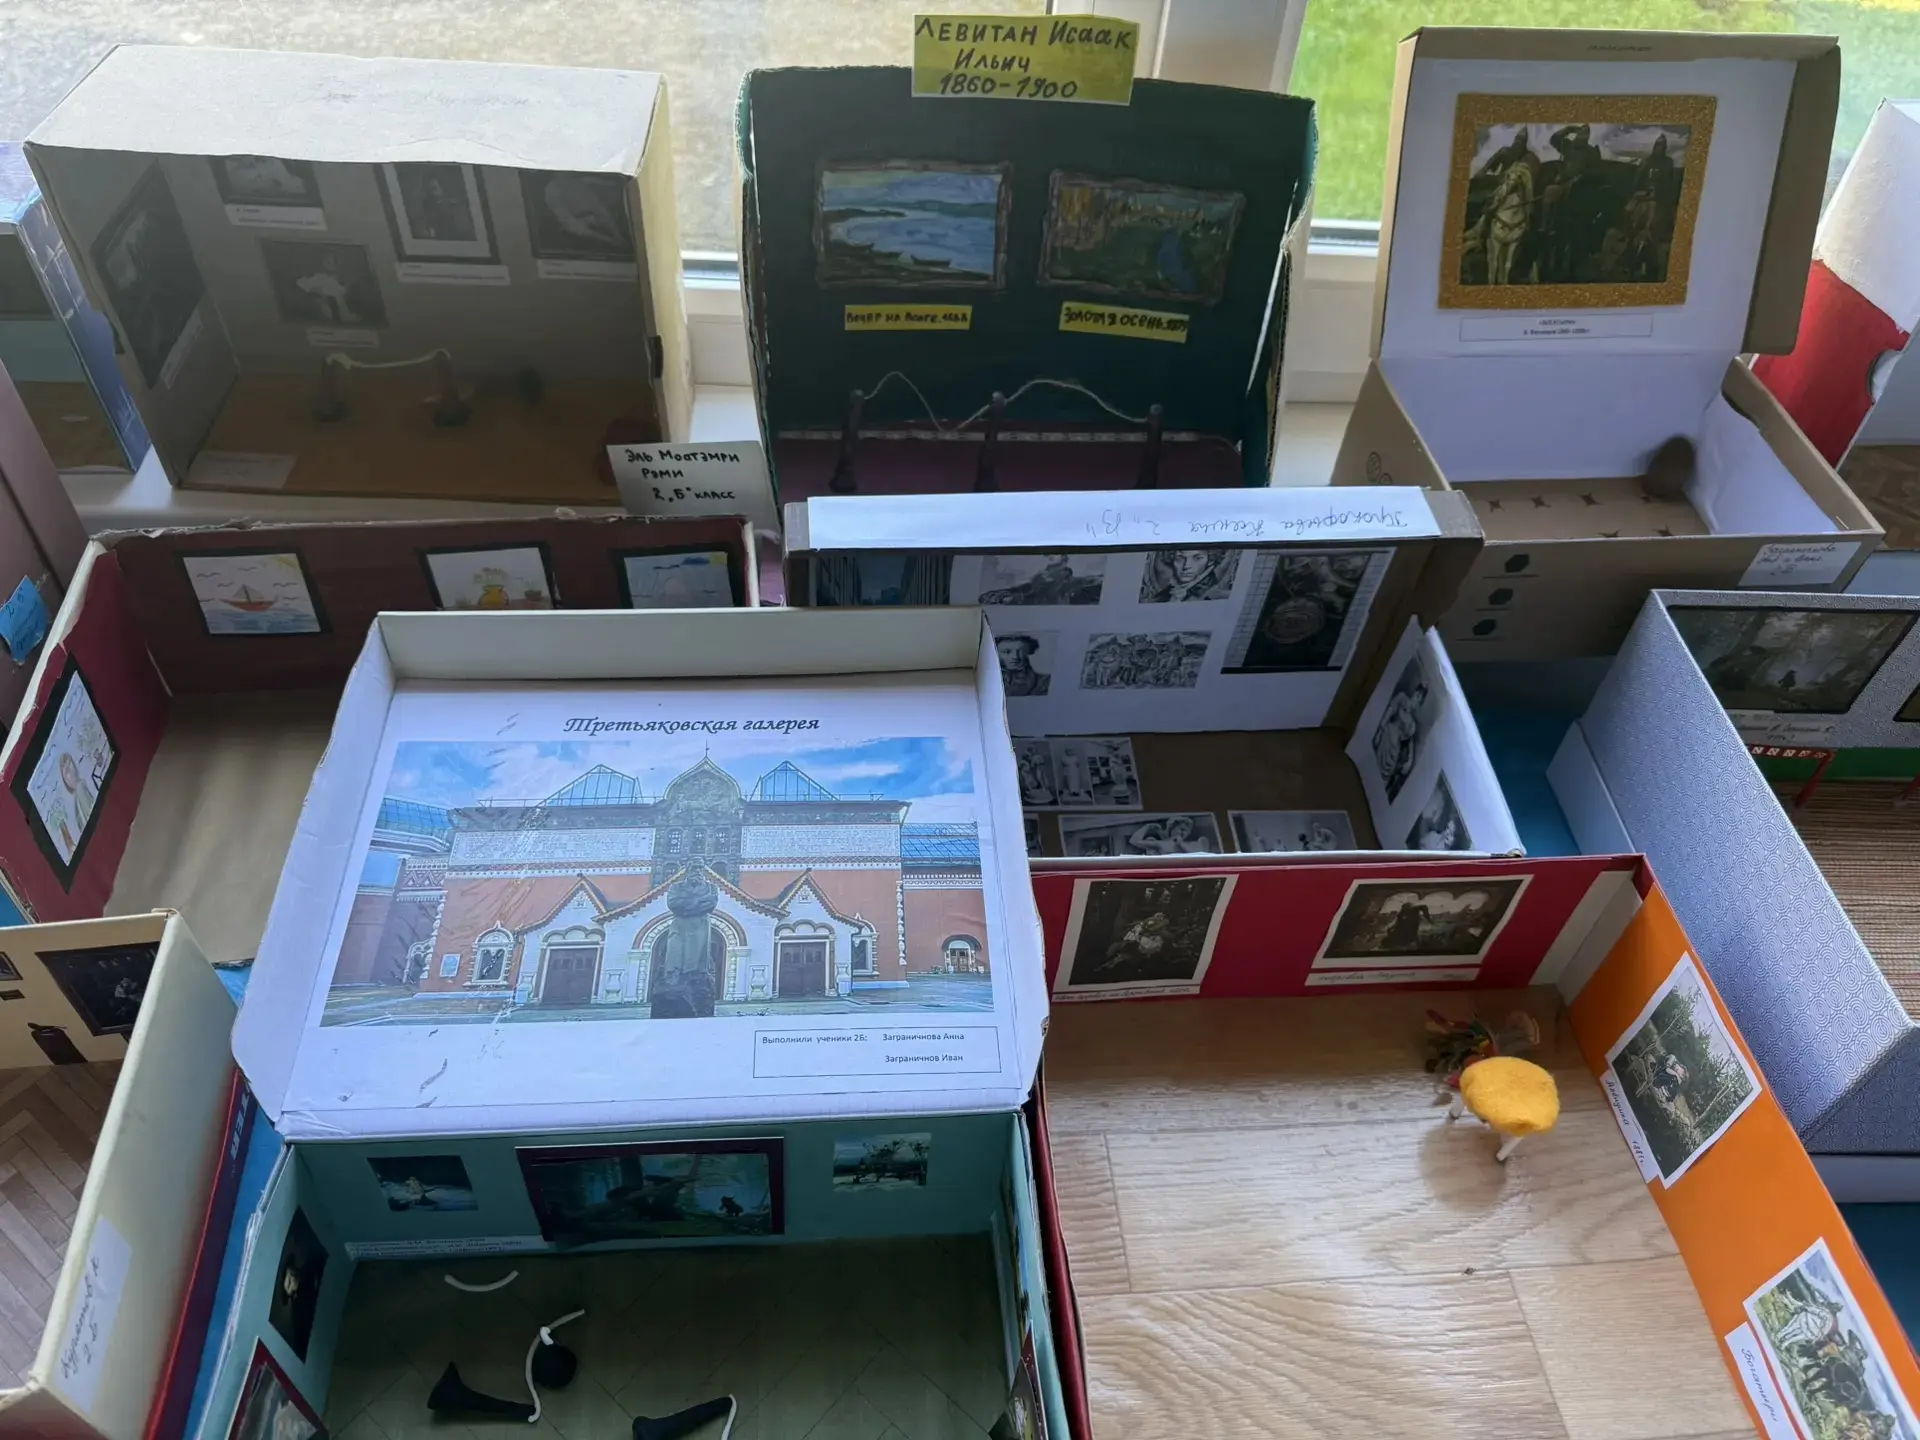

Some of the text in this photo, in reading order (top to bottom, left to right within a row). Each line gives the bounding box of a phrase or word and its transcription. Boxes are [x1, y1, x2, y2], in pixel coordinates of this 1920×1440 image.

[915, 17, 1132, 49] ЛЕВИТАН Исаак
[954, 48, 1030, 73] Ильич
[940, 73, 1078, 98] 1860-1900
[563, 717, 820, 736] Третьяковская галерея
[762, 1035, 813, 1045] Выполнили
[816, 1035, 852, 1044] ученики
[883, 1033, 941, 1042] Заграничнова
[943, 1033, 965, 1041] Анна
[885, 1054, 964, 1064] Заграничнов Иван
